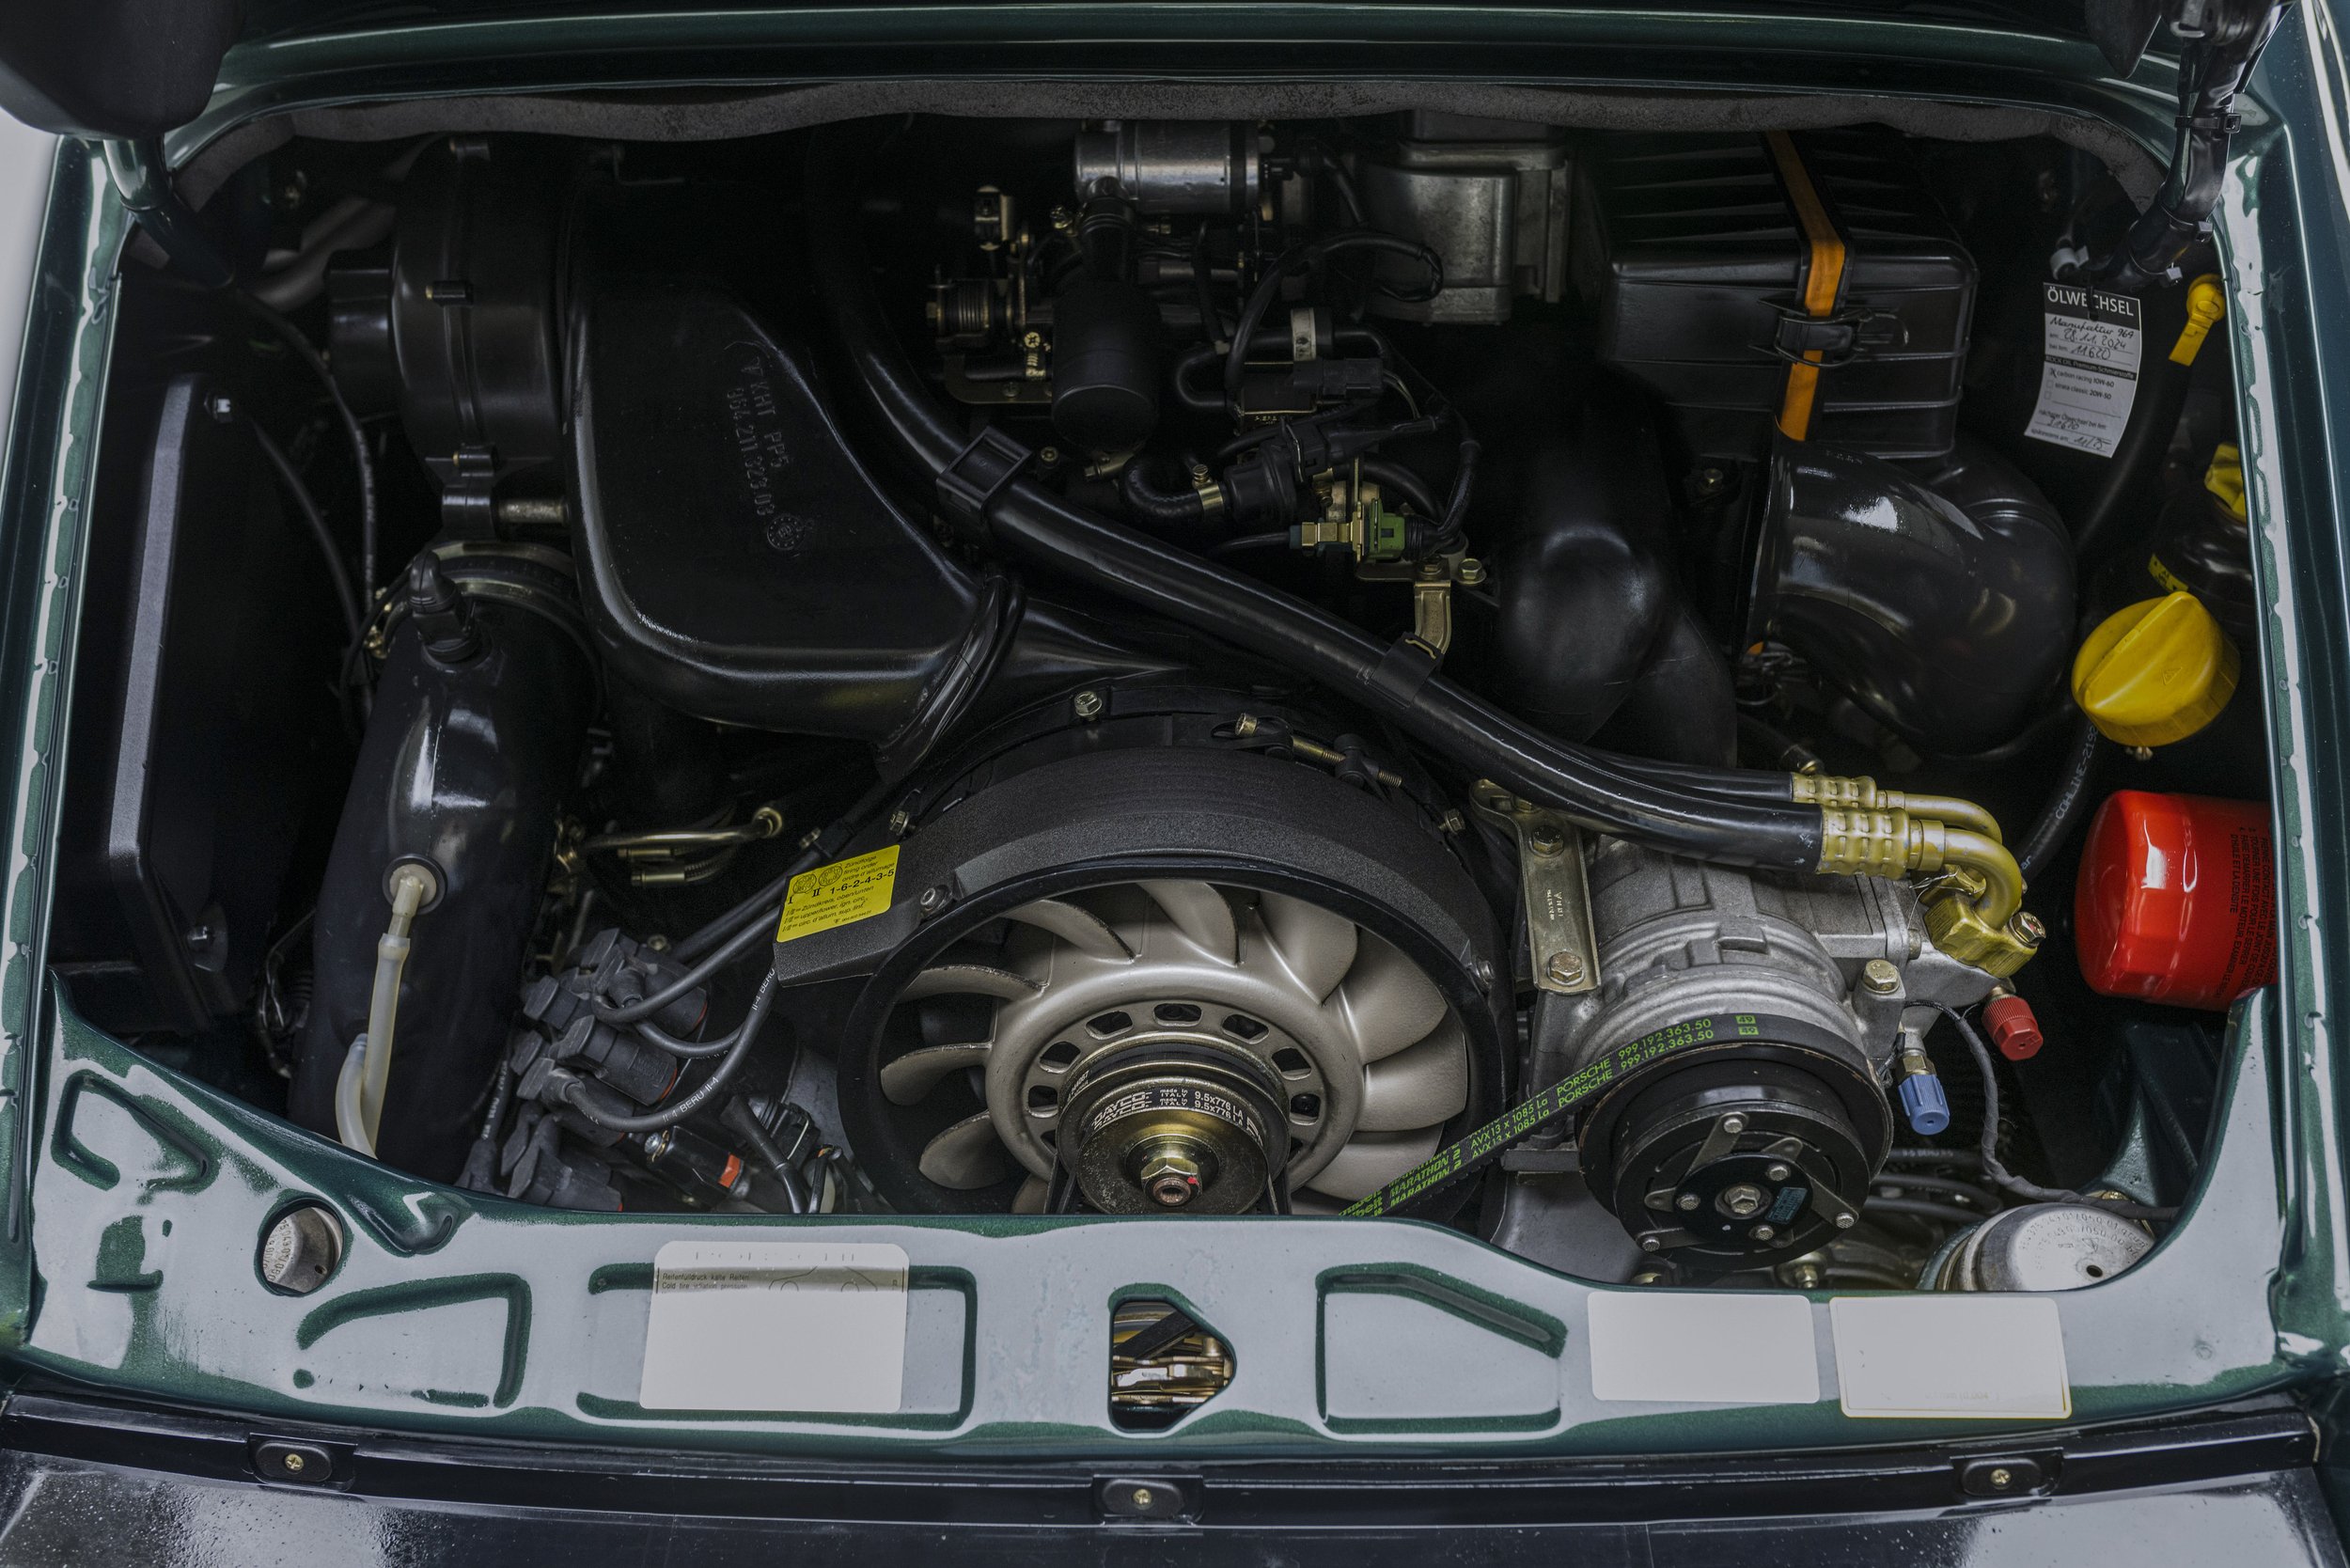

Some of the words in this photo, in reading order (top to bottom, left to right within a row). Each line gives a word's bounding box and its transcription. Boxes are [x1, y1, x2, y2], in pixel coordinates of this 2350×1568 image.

[830, 869, 895, 894] 1-6-2-4-3-5
[1557, 1059, 1611, 1096] PORSCHE
[1618, 1018, 1712, 1060] 999.192.363.50
[1558, 1069, 1613, 1109] PORSCHE
[1620, 1029, 1714, 1072] 999.192.363.50
[680, 1090, 705, 1113] BERU
[1194, 1090, 1231, 1110] 9.5x776
[1232, 1105, 1244, 1120] LA
[1194, 1100, 1231, 1119] 9.5x776
[1389, 1154, 1449, 1197] MARATHON
[1452, 1147, 1461, 1161] 2
[1470, 1123, 1501, 1150] AVX13
[1512, 1104, 1534, 1122] 1085
[1537, 1097, 1548, 1109] La
[1390, 1166, 1450, 1207] MARATHON
[1453, 1160, 1462, 1171] 2
[1471, 1135, 1502, 1159] AVX13
[1513, 1114, 1536, 1135] 1085
[1539, 1108, 1550, 1120] La
